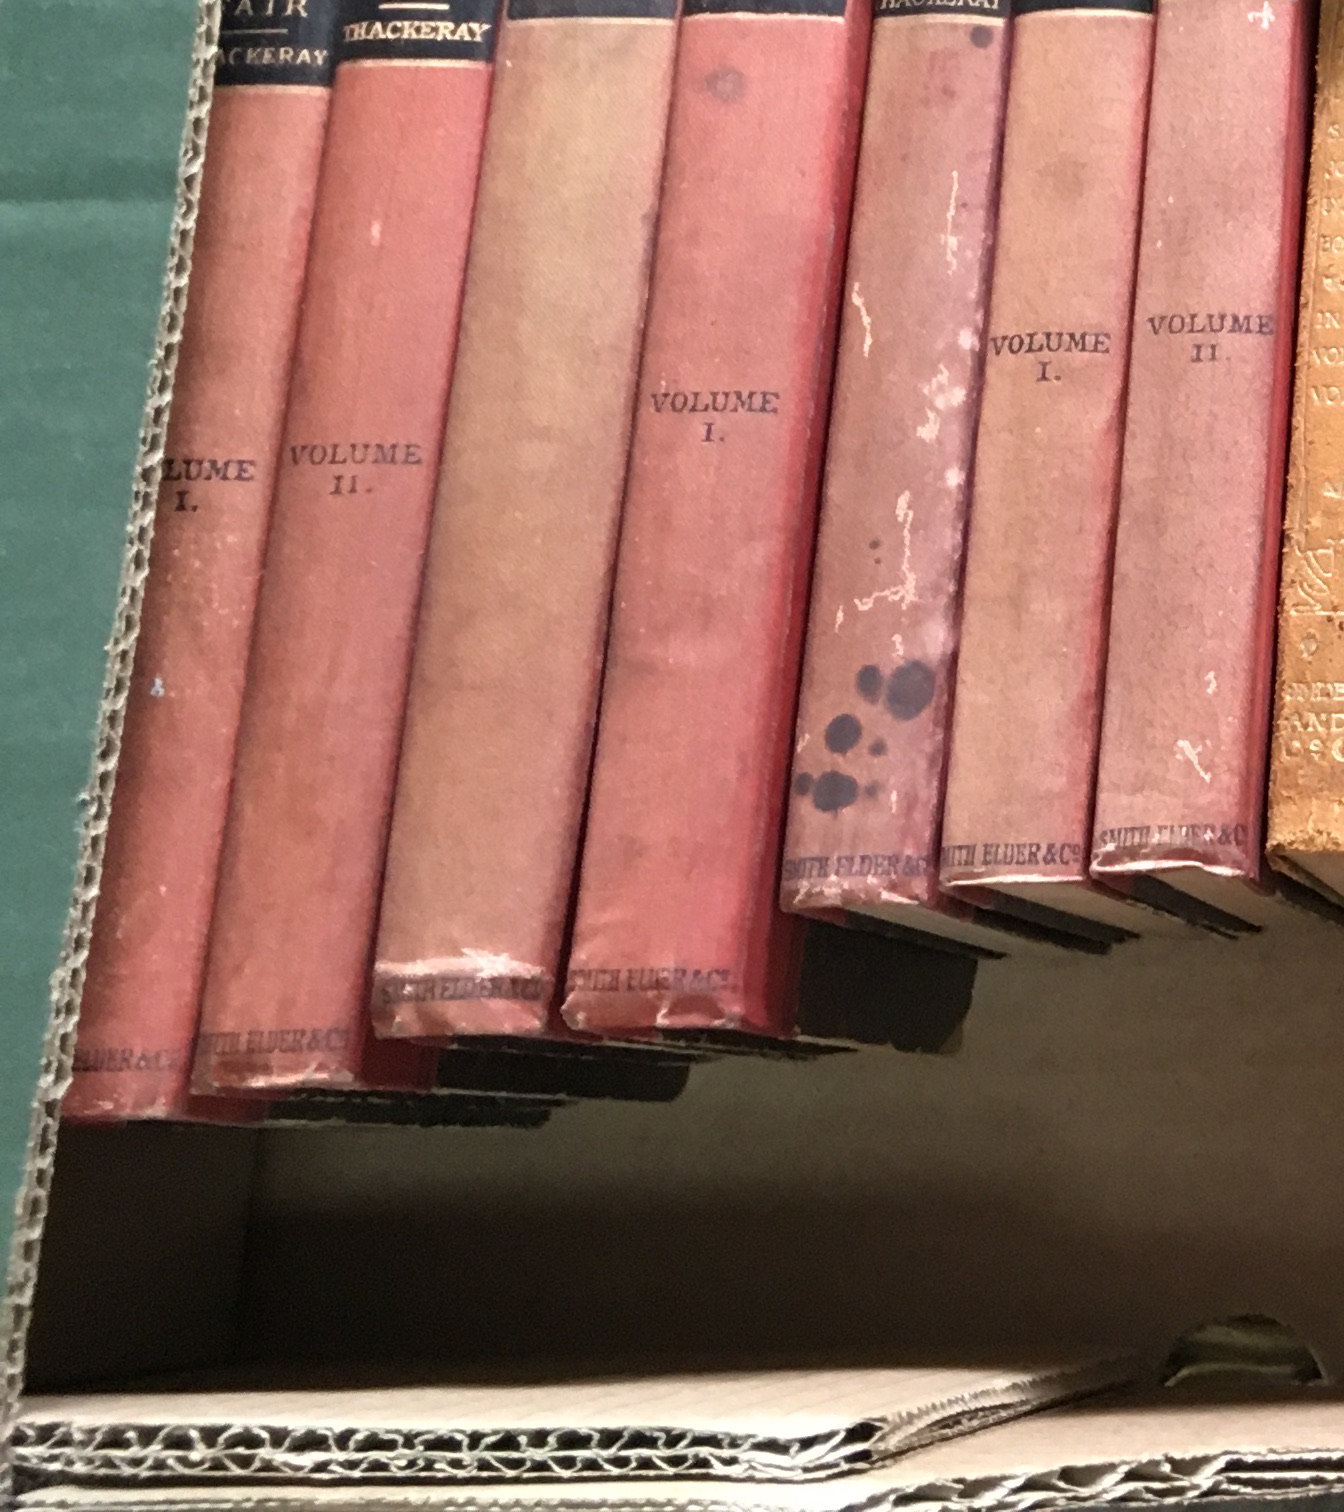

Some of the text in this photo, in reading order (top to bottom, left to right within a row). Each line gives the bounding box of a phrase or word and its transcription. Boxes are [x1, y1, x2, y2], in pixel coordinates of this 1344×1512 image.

[344, 20, 493, 43] THACKERAY
[1146, 312, 1276, 336] VOLUME
[990, 330, 1112, 356] VOLUME
[1035, 360, 1062, 383] I.
[650, 390, 781, 414] VOLUME
[701, 421, 726, 443] I.
[289, 442, 424, 467] VOLUME
[161, 458, 257, 483] LUME
